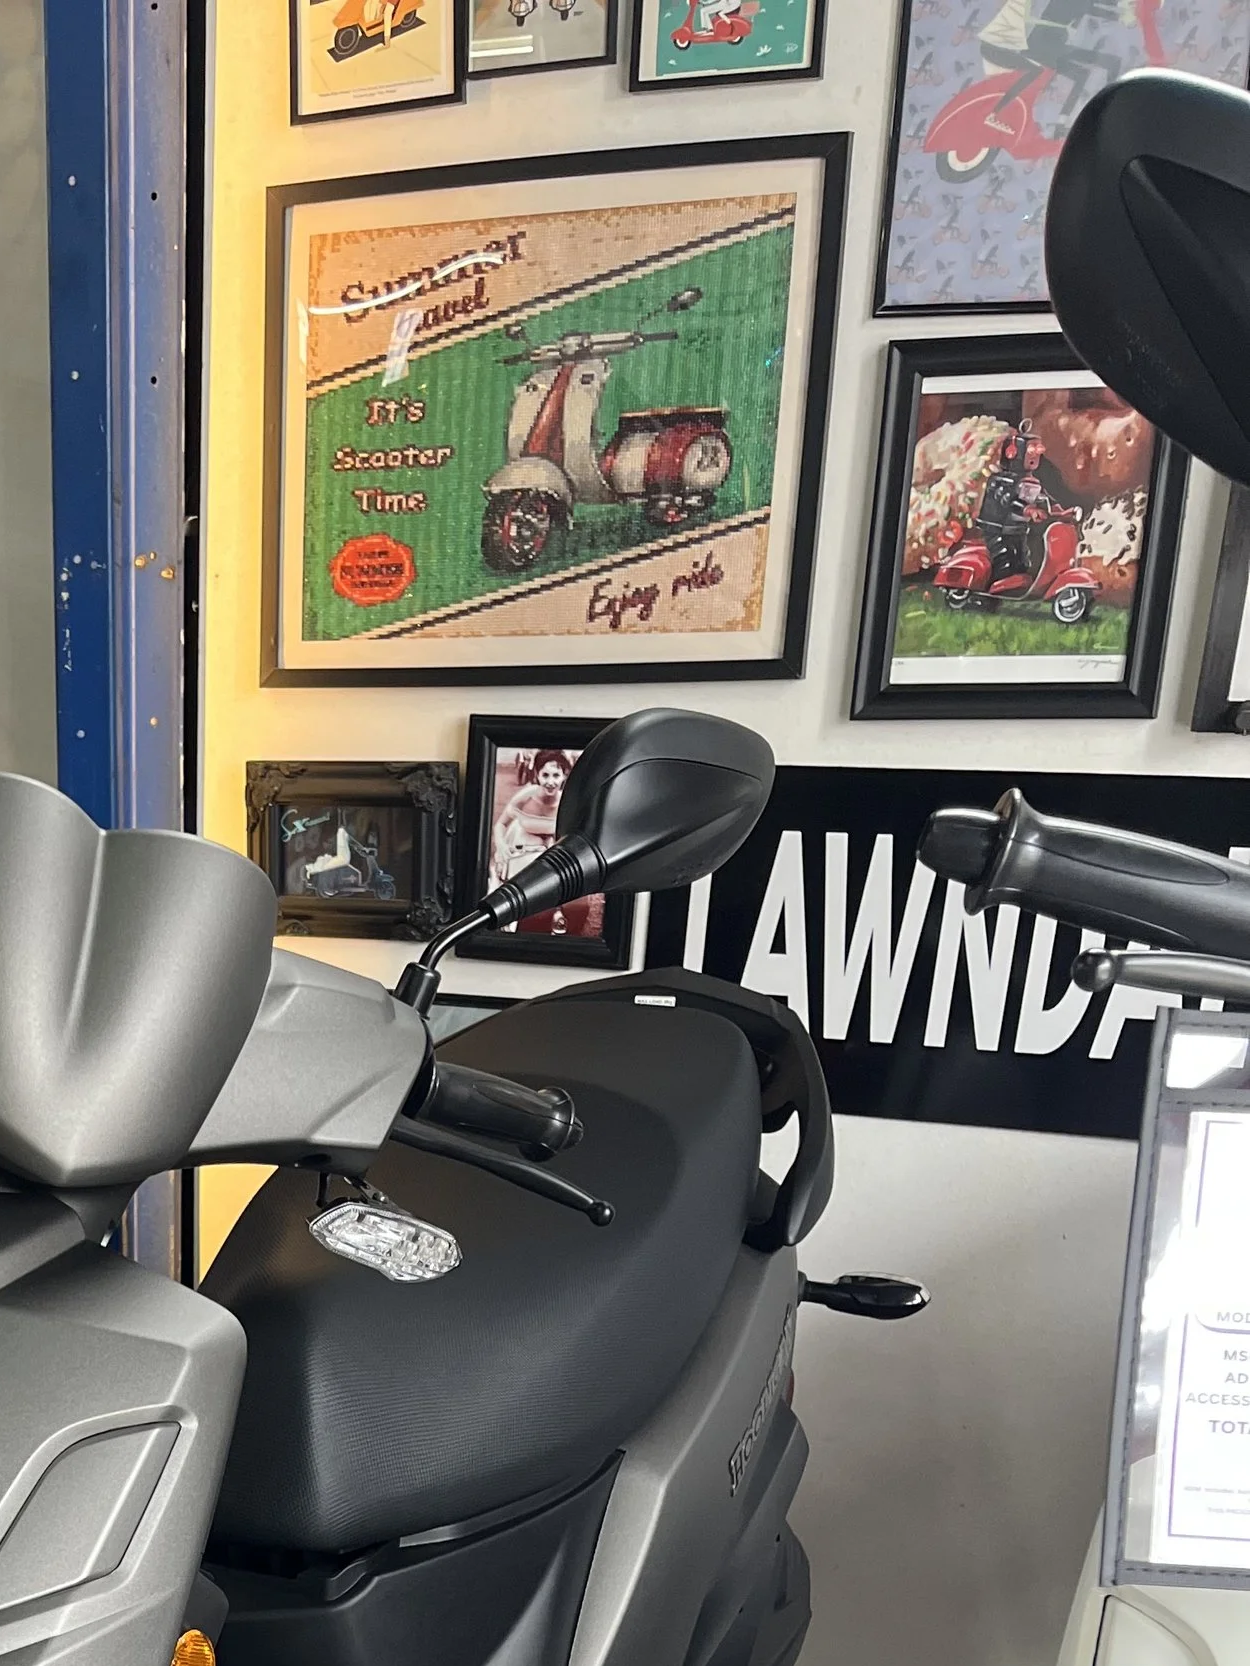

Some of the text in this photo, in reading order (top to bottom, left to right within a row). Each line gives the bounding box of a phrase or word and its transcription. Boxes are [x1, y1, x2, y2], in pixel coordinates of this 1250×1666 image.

[366, 393, 426, 426] It's
[332, 444, 454, 471] Scooter
[352, 487, 429, 514] Time
[1209, 1420, 1250, 1434] TOT
